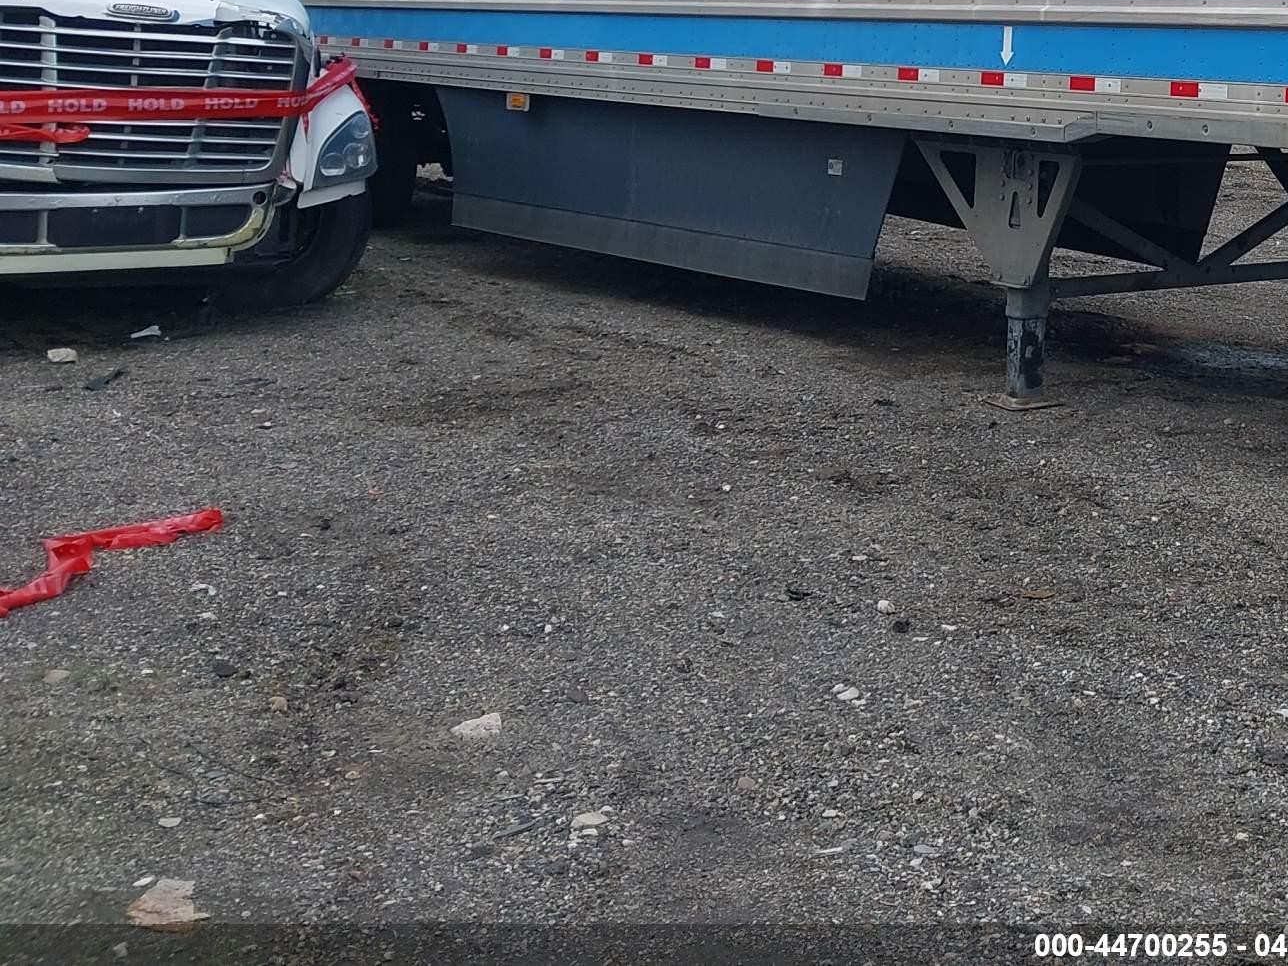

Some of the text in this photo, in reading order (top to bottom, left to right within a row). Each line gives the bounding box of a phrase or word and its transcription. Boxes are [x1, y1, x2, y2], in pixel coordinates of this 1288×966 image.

[47, 98, 107, 113] HOLD
[128, 97, 184, 111] HOLD
[205, 97, 258, 110] HOLD
